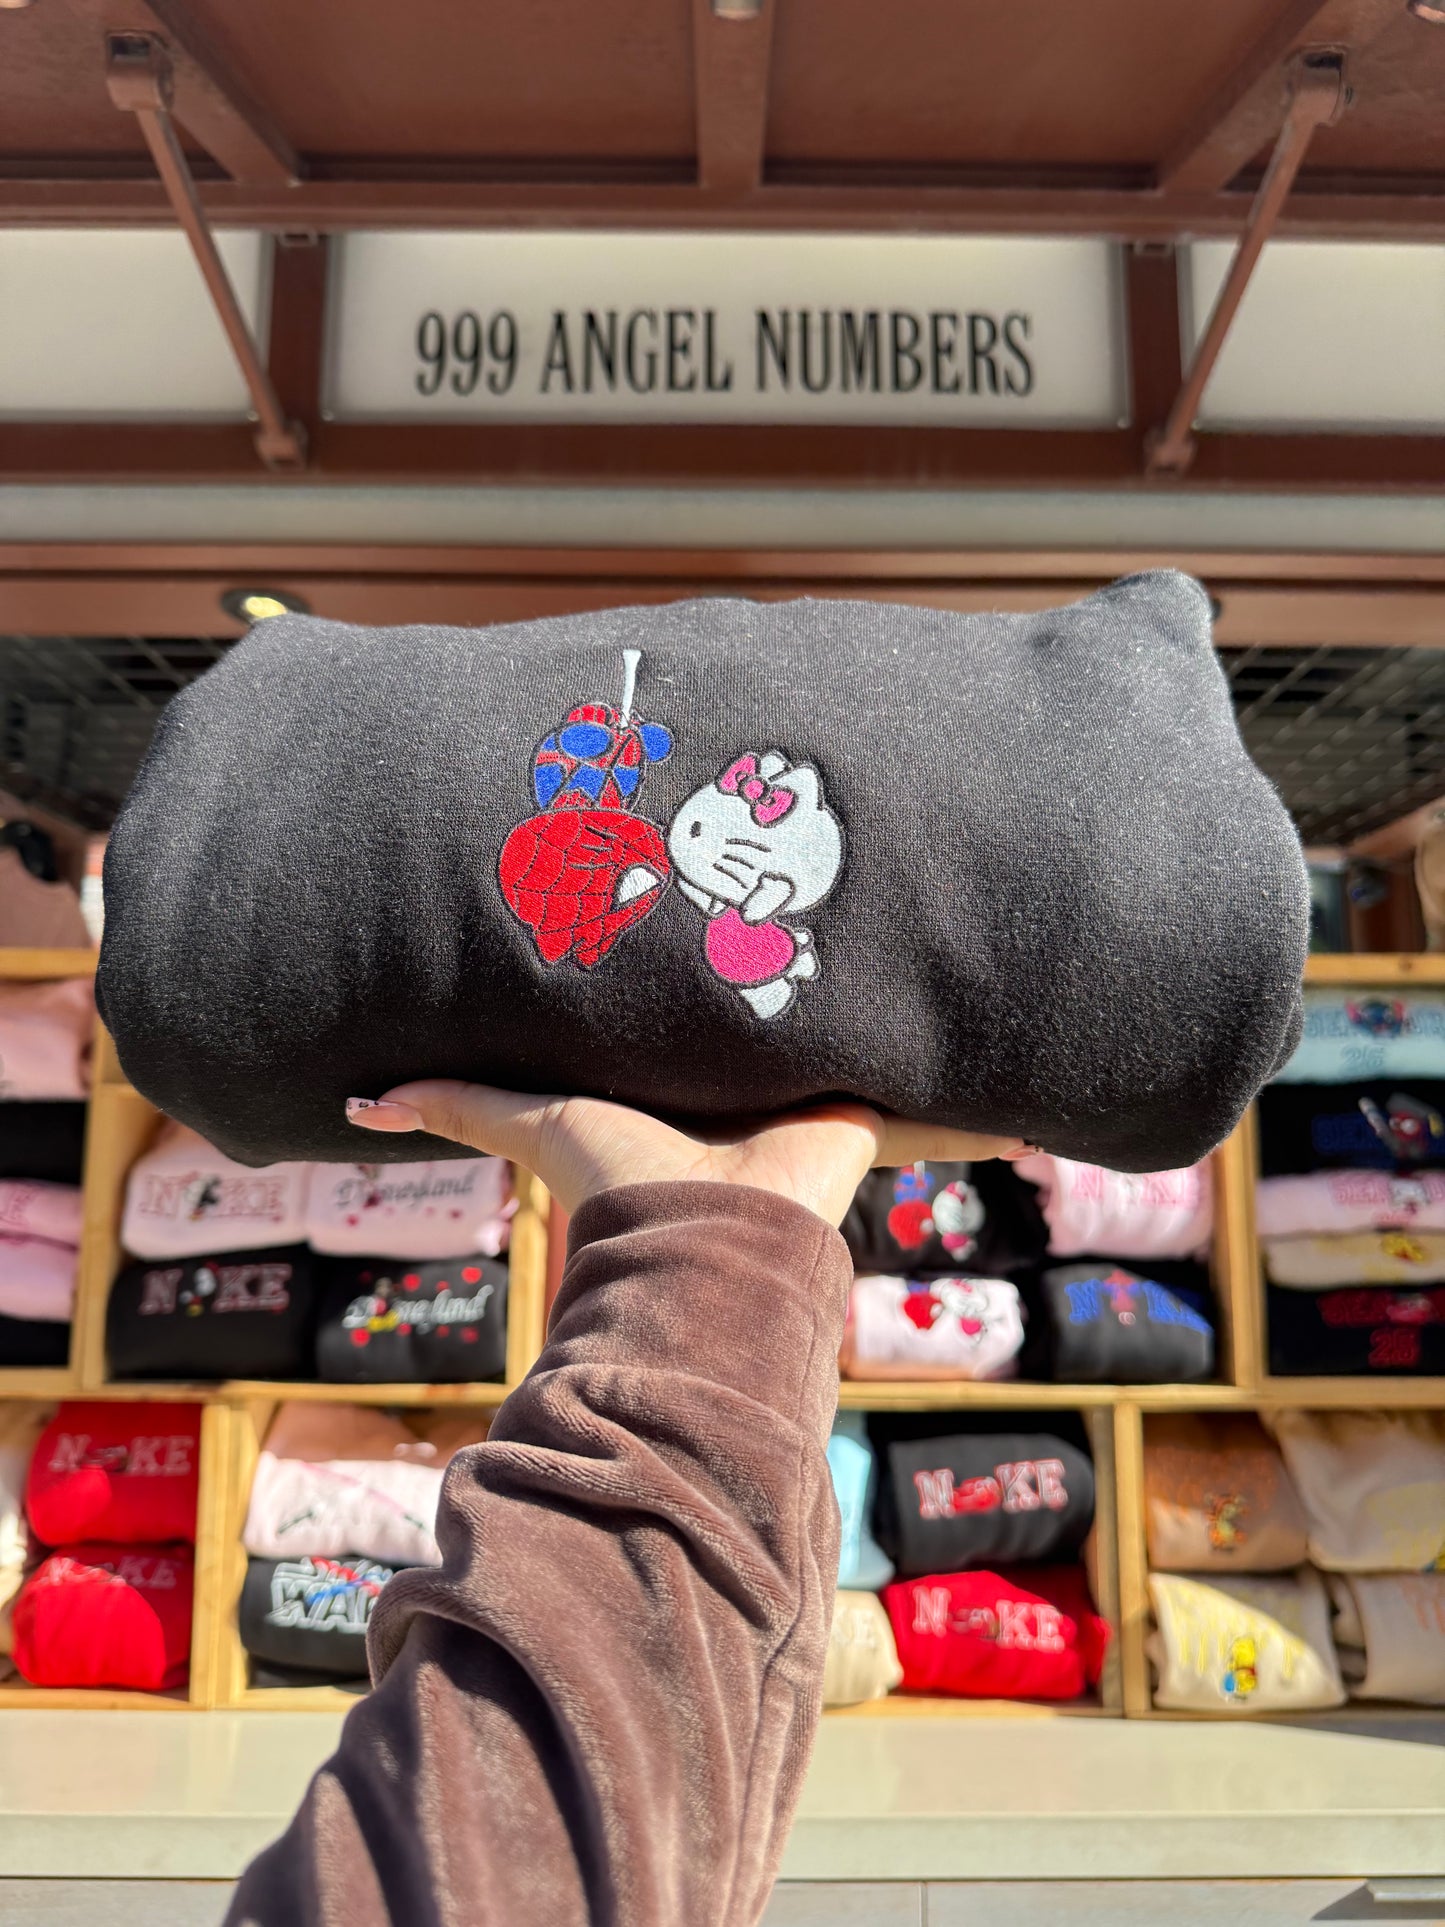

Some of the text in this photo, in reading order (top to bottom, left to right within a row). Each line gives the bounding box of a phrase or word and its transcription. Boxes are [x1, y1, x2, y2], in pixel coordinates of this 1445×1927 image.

[416, 309, 1036, 397] 999 ANGEL NUMBERS
[138, 1263, 293, 1315] NKE
[48, 1433, 194, 1477] NKE
[913, 1458, 1069, 1520] NKE
[911, 1585, 1065, 1653] NKE
